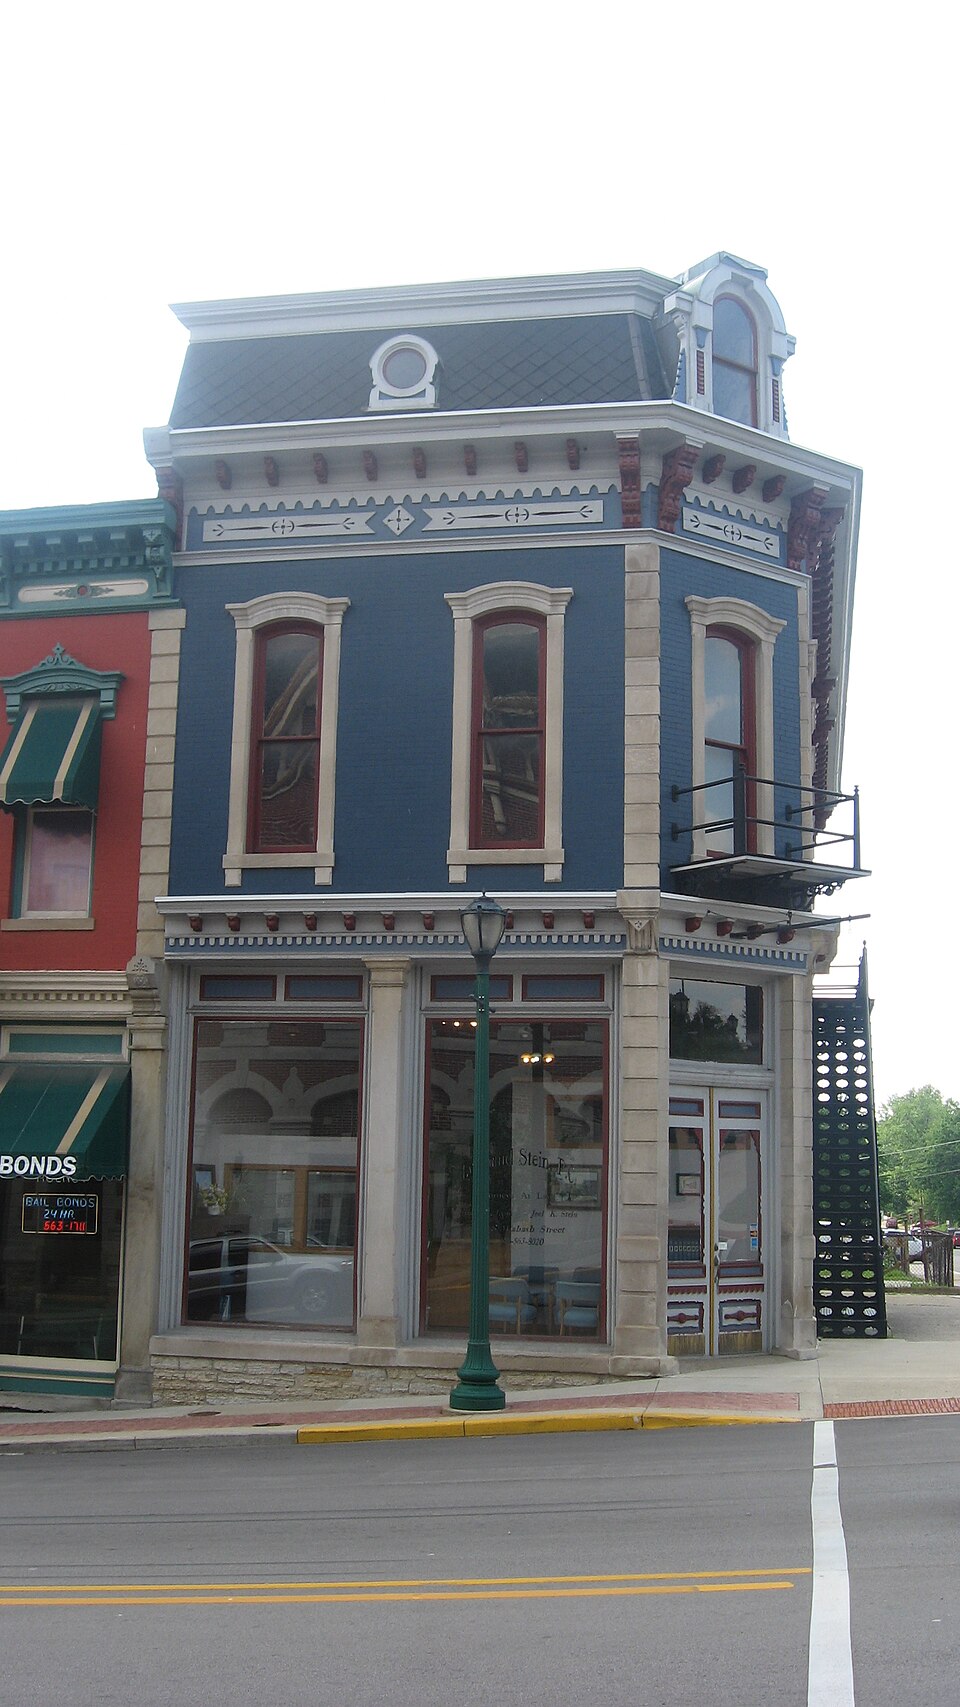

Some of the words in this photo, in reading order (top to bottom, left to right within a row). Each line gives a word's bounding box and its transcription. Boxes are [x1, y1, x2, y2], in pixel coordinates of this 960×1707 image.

[519, 1148, 549, 1170] Stein
[0, 1155, 77, 1176] BONDS
[25, 1196, 50, 1207] BAIL
[56, 1197, 95, 1208] BONDS
[43, 1209, 57, 1219] 24
[43, 1221, 87, 1232] 563-1711
[540, 1225, 566, 1234] Street
